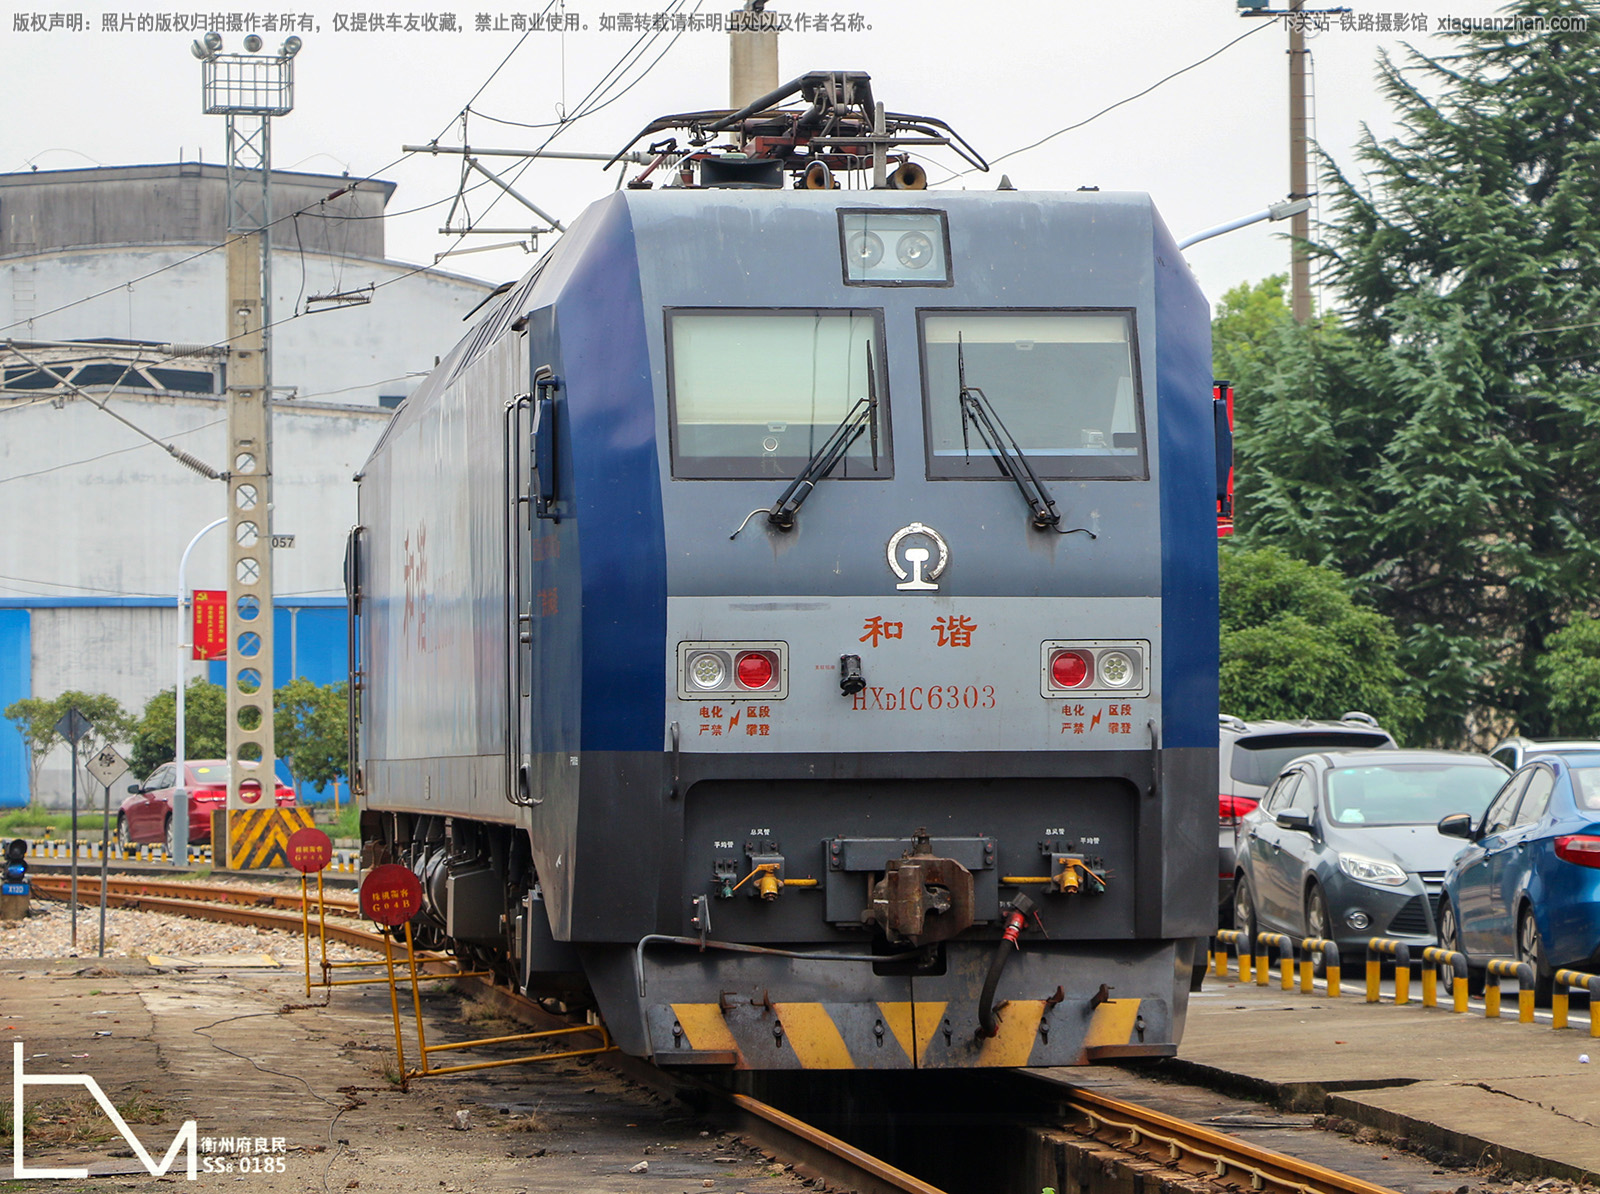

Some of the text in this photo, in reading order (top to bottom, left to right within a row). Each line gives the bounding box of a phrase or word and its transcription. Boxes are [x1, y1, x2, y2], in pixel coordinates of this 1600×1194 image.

[271, 537, 295, 548] 057
[859, 615, 977, 648] 和谐
[699, 706, 770, 718] 电化 区段
[1062, 704, 1132, 716] 电化 区段
[699, 724, 722, 736] 严禁
[1061, 722, 1084, 734] 严禁
